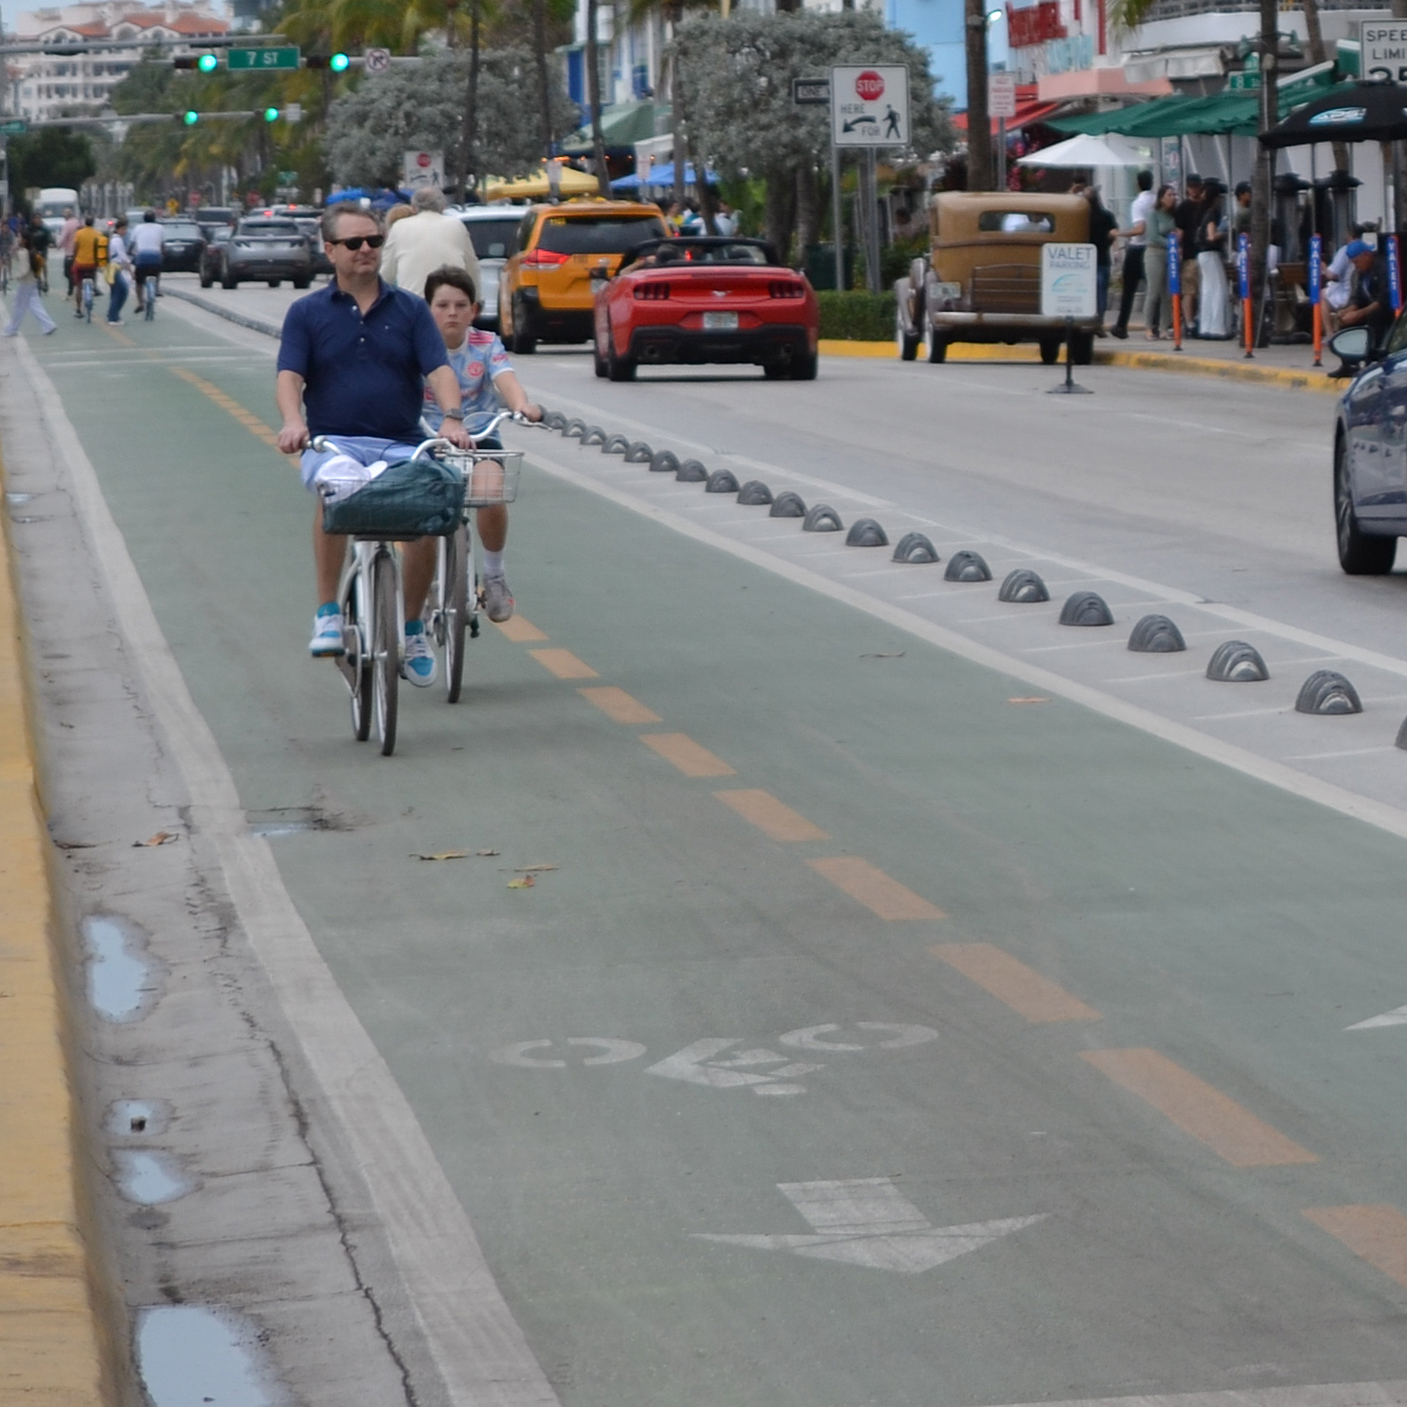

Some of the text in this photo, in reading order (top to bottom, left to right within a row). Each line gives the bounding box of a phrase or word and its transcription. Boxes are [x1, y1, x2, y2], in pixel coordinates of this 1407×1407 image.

[246, 51, 279, 65] 7 ST
[857, 79, 884, 92] STOP
[840, 103, 866, 114] HERE
[861, 125, 881, 136] FOR
[1047, 247, 1093, 260] VALET
[1168, 236, 1178, 279] VALET
[1239, 237, 1248, 282] VALET
[1049, 261, 1091, 269] PARKING
[1311, 240, 1320, 287] VALET
[1388, 241, 1398, 291] VALET
